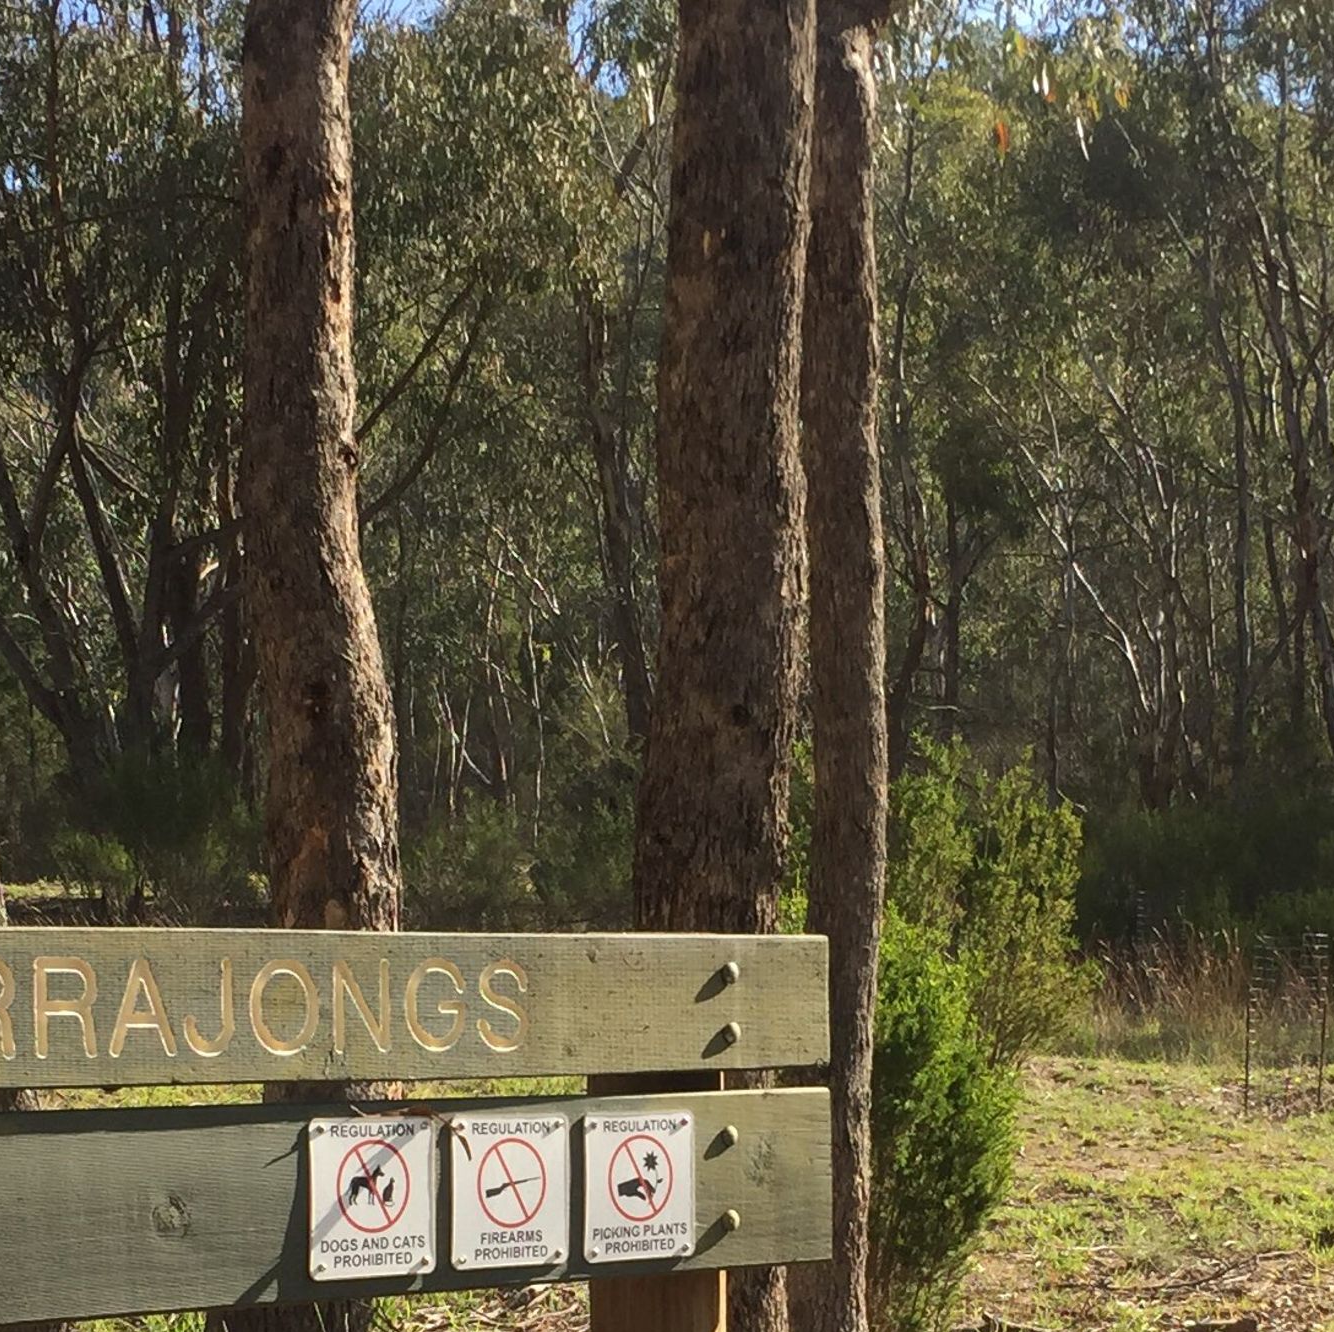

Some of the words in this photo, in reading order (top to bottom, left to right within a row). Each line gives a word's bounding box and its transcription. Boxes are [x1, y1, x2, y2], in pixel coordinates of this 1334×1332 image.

[330, 1122, 415, 1138] REGULATION
[471, 1120, 550, 1136] REGULATION
[603, 1119, 677, 1133] REGULATION
[480, 1230, 543, 1245] FIREARMS
[592, 1225, 640, 1240] PICKING
[643, 1222, 688, 1236] PLANTS
[320, 1238, 358, 1253] DOGS
[361, 1236, 390, 1250] AND
[394, 1235, 425, 1249] CATS
[605, 1238, 675, 1254] PROHIBITED
[334, 1252, 413, 1268] PROHIBITED
[474, 1245, 548, 1261] PROHIBITED
